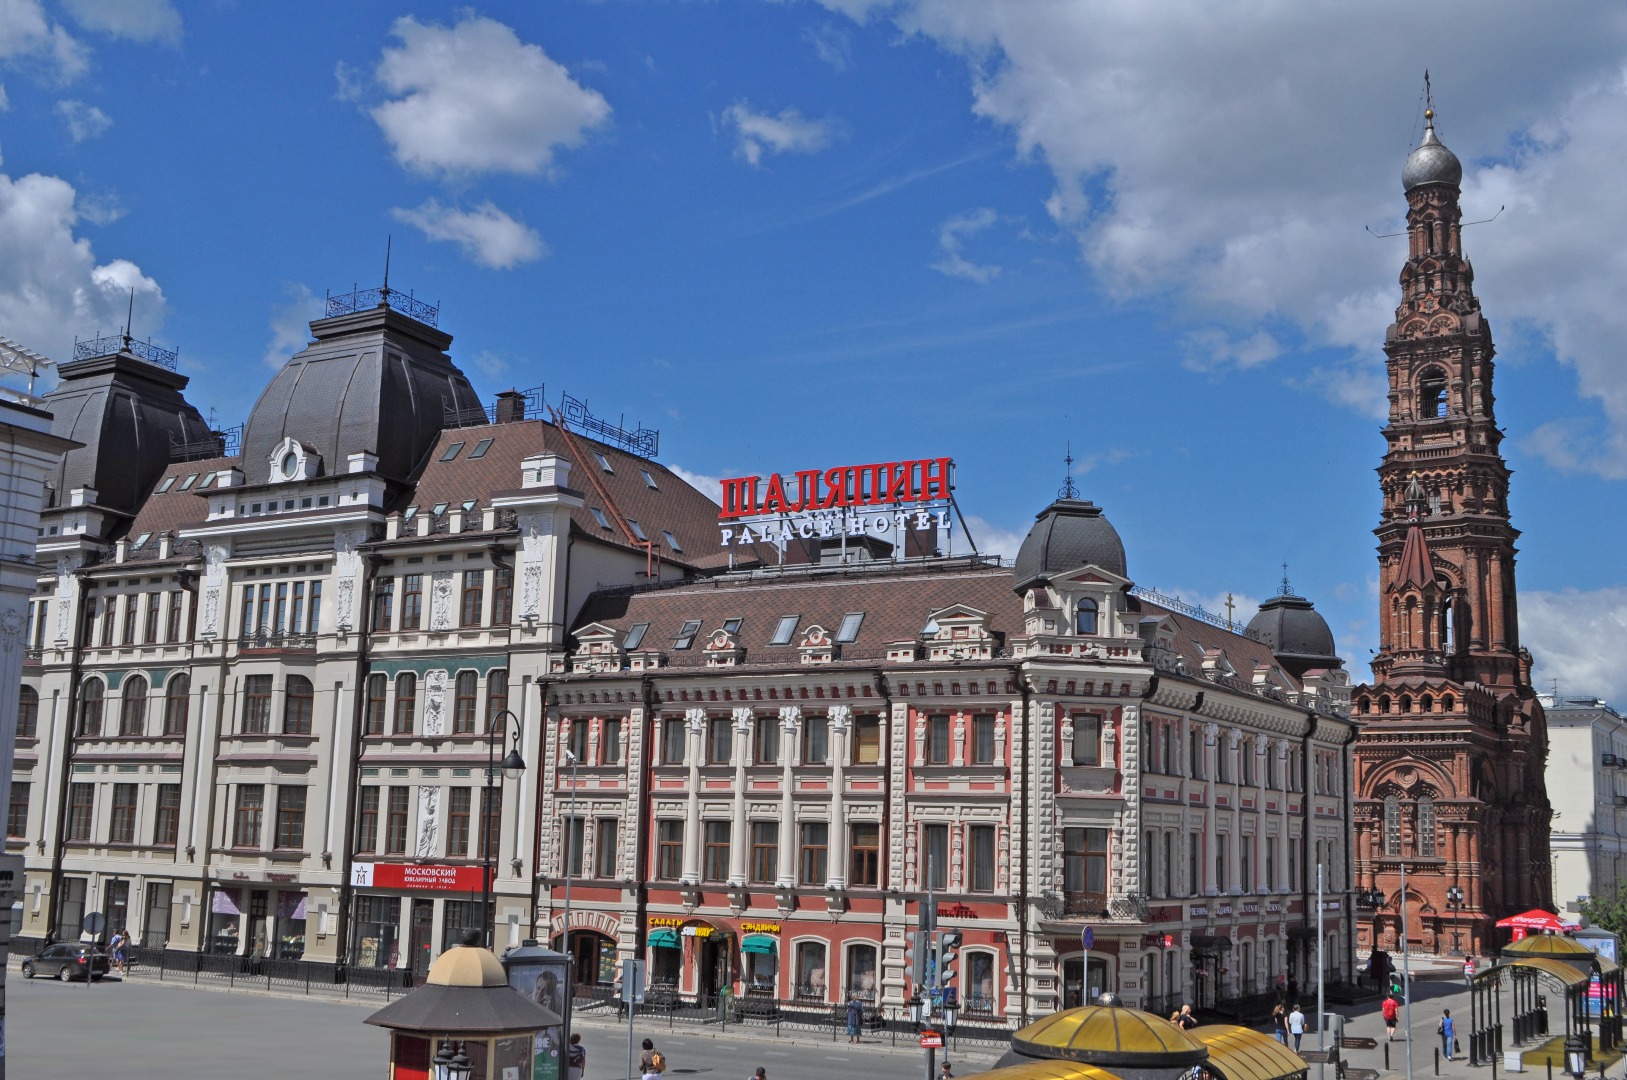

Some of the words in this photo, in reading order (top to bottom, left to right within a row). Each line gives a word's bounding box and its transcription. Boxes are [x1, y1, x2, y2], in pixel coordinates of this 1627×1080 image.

[718, 457, 953, 518] ШАЛЯПИН
[721, 519, 834, 546] PALACE
[850, 511, 952, 536] HOTEL
[405, 867, 456, 877] МОСКОВСКИЙ
[649, 918, 683, 926] САЛАТЫ
[741, 922, 780, 932] СЭНДВИЧИ
[681, 927, 714, 937] SUBWAY
